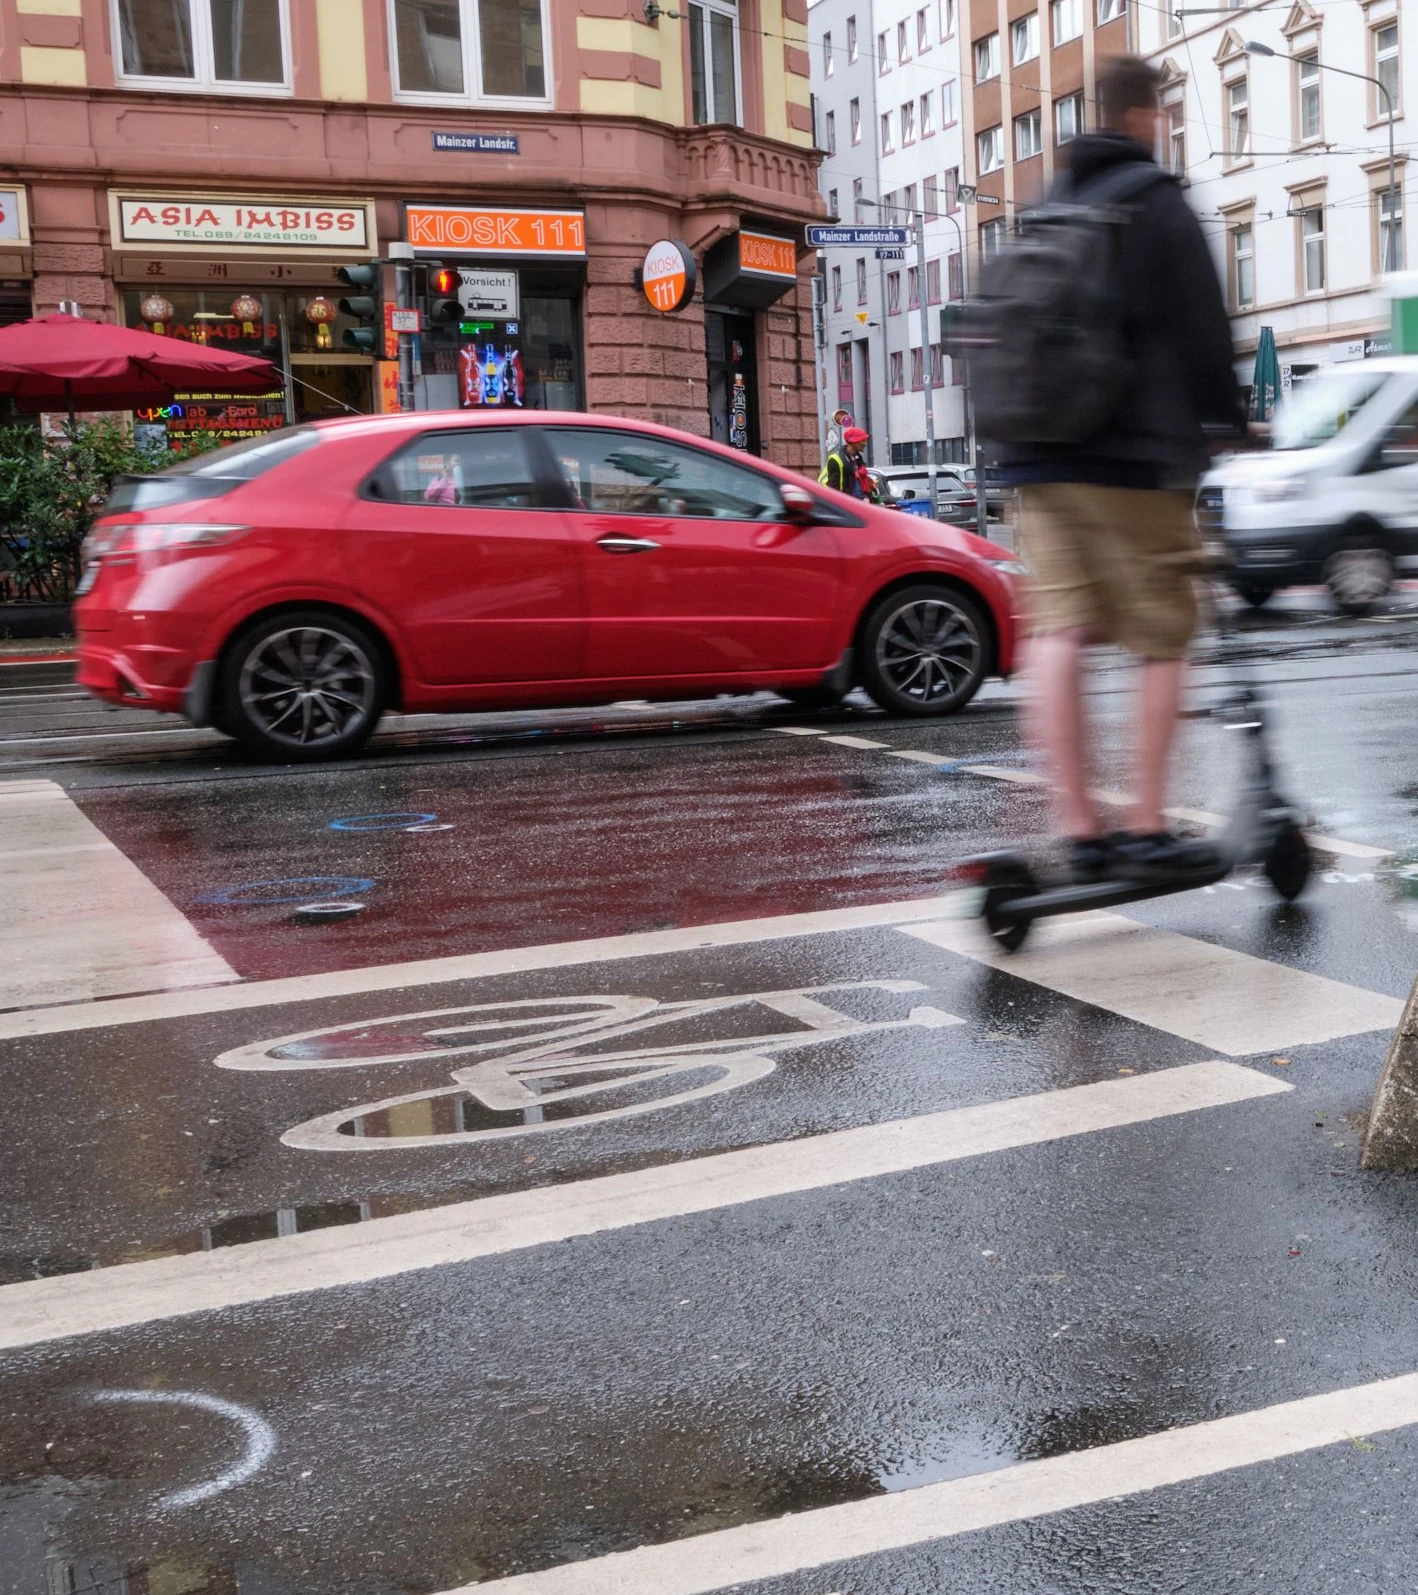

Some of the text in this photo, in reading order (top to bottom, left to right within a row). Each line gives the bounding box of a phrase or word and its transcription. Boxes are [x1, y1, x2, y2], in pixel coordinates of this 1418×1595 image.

[437, 135, 516, 150] Mainzer Landstr.
[131, 206, 356, 231] ASIA IMBISS
[411, 214, 582, 246] KIOSK 111
[818, 230, 900, 242] Mainzer Landstraße
[647, 254, 680, 276] KIOSK
[742, 239, 796, 269] KIOSK 111
[146, 261, 341, 279] 亞洲小
[653, 280, 677, 308] 111
